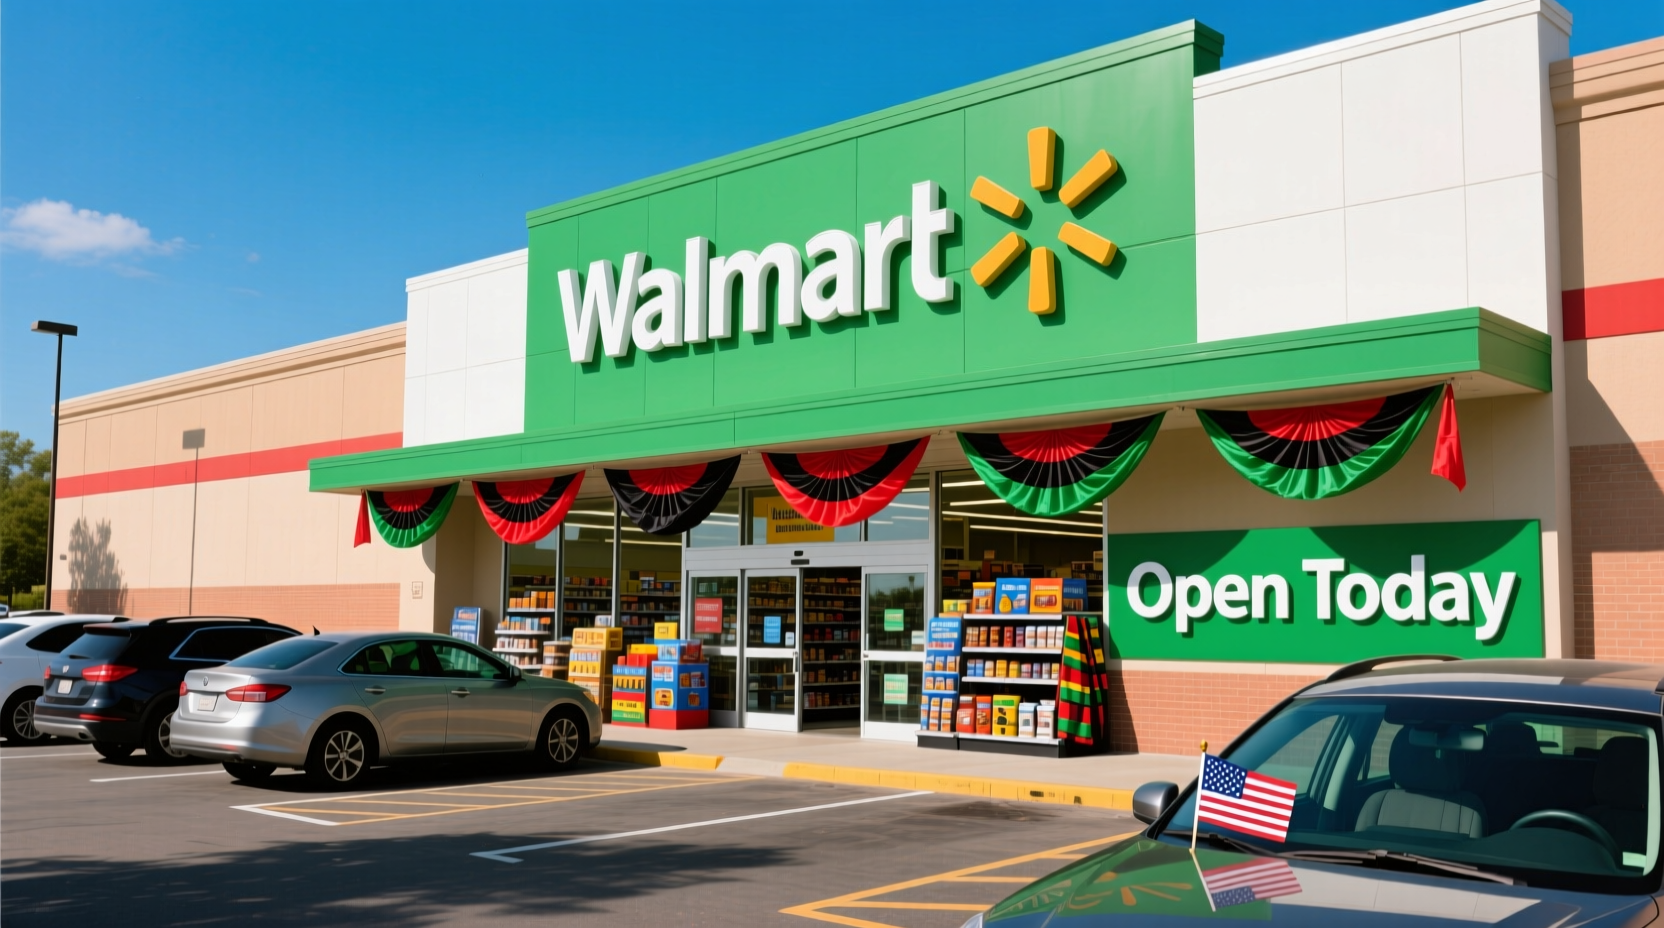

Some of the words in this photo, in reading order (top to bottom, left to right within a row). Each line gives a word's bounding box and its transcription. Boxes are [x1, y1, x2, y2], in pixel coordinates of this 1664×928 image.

[557, 180, 955, 364] Walmart
[1126, 561, 1290, 633] Open
[1301, 554, 1517, 641] Today
